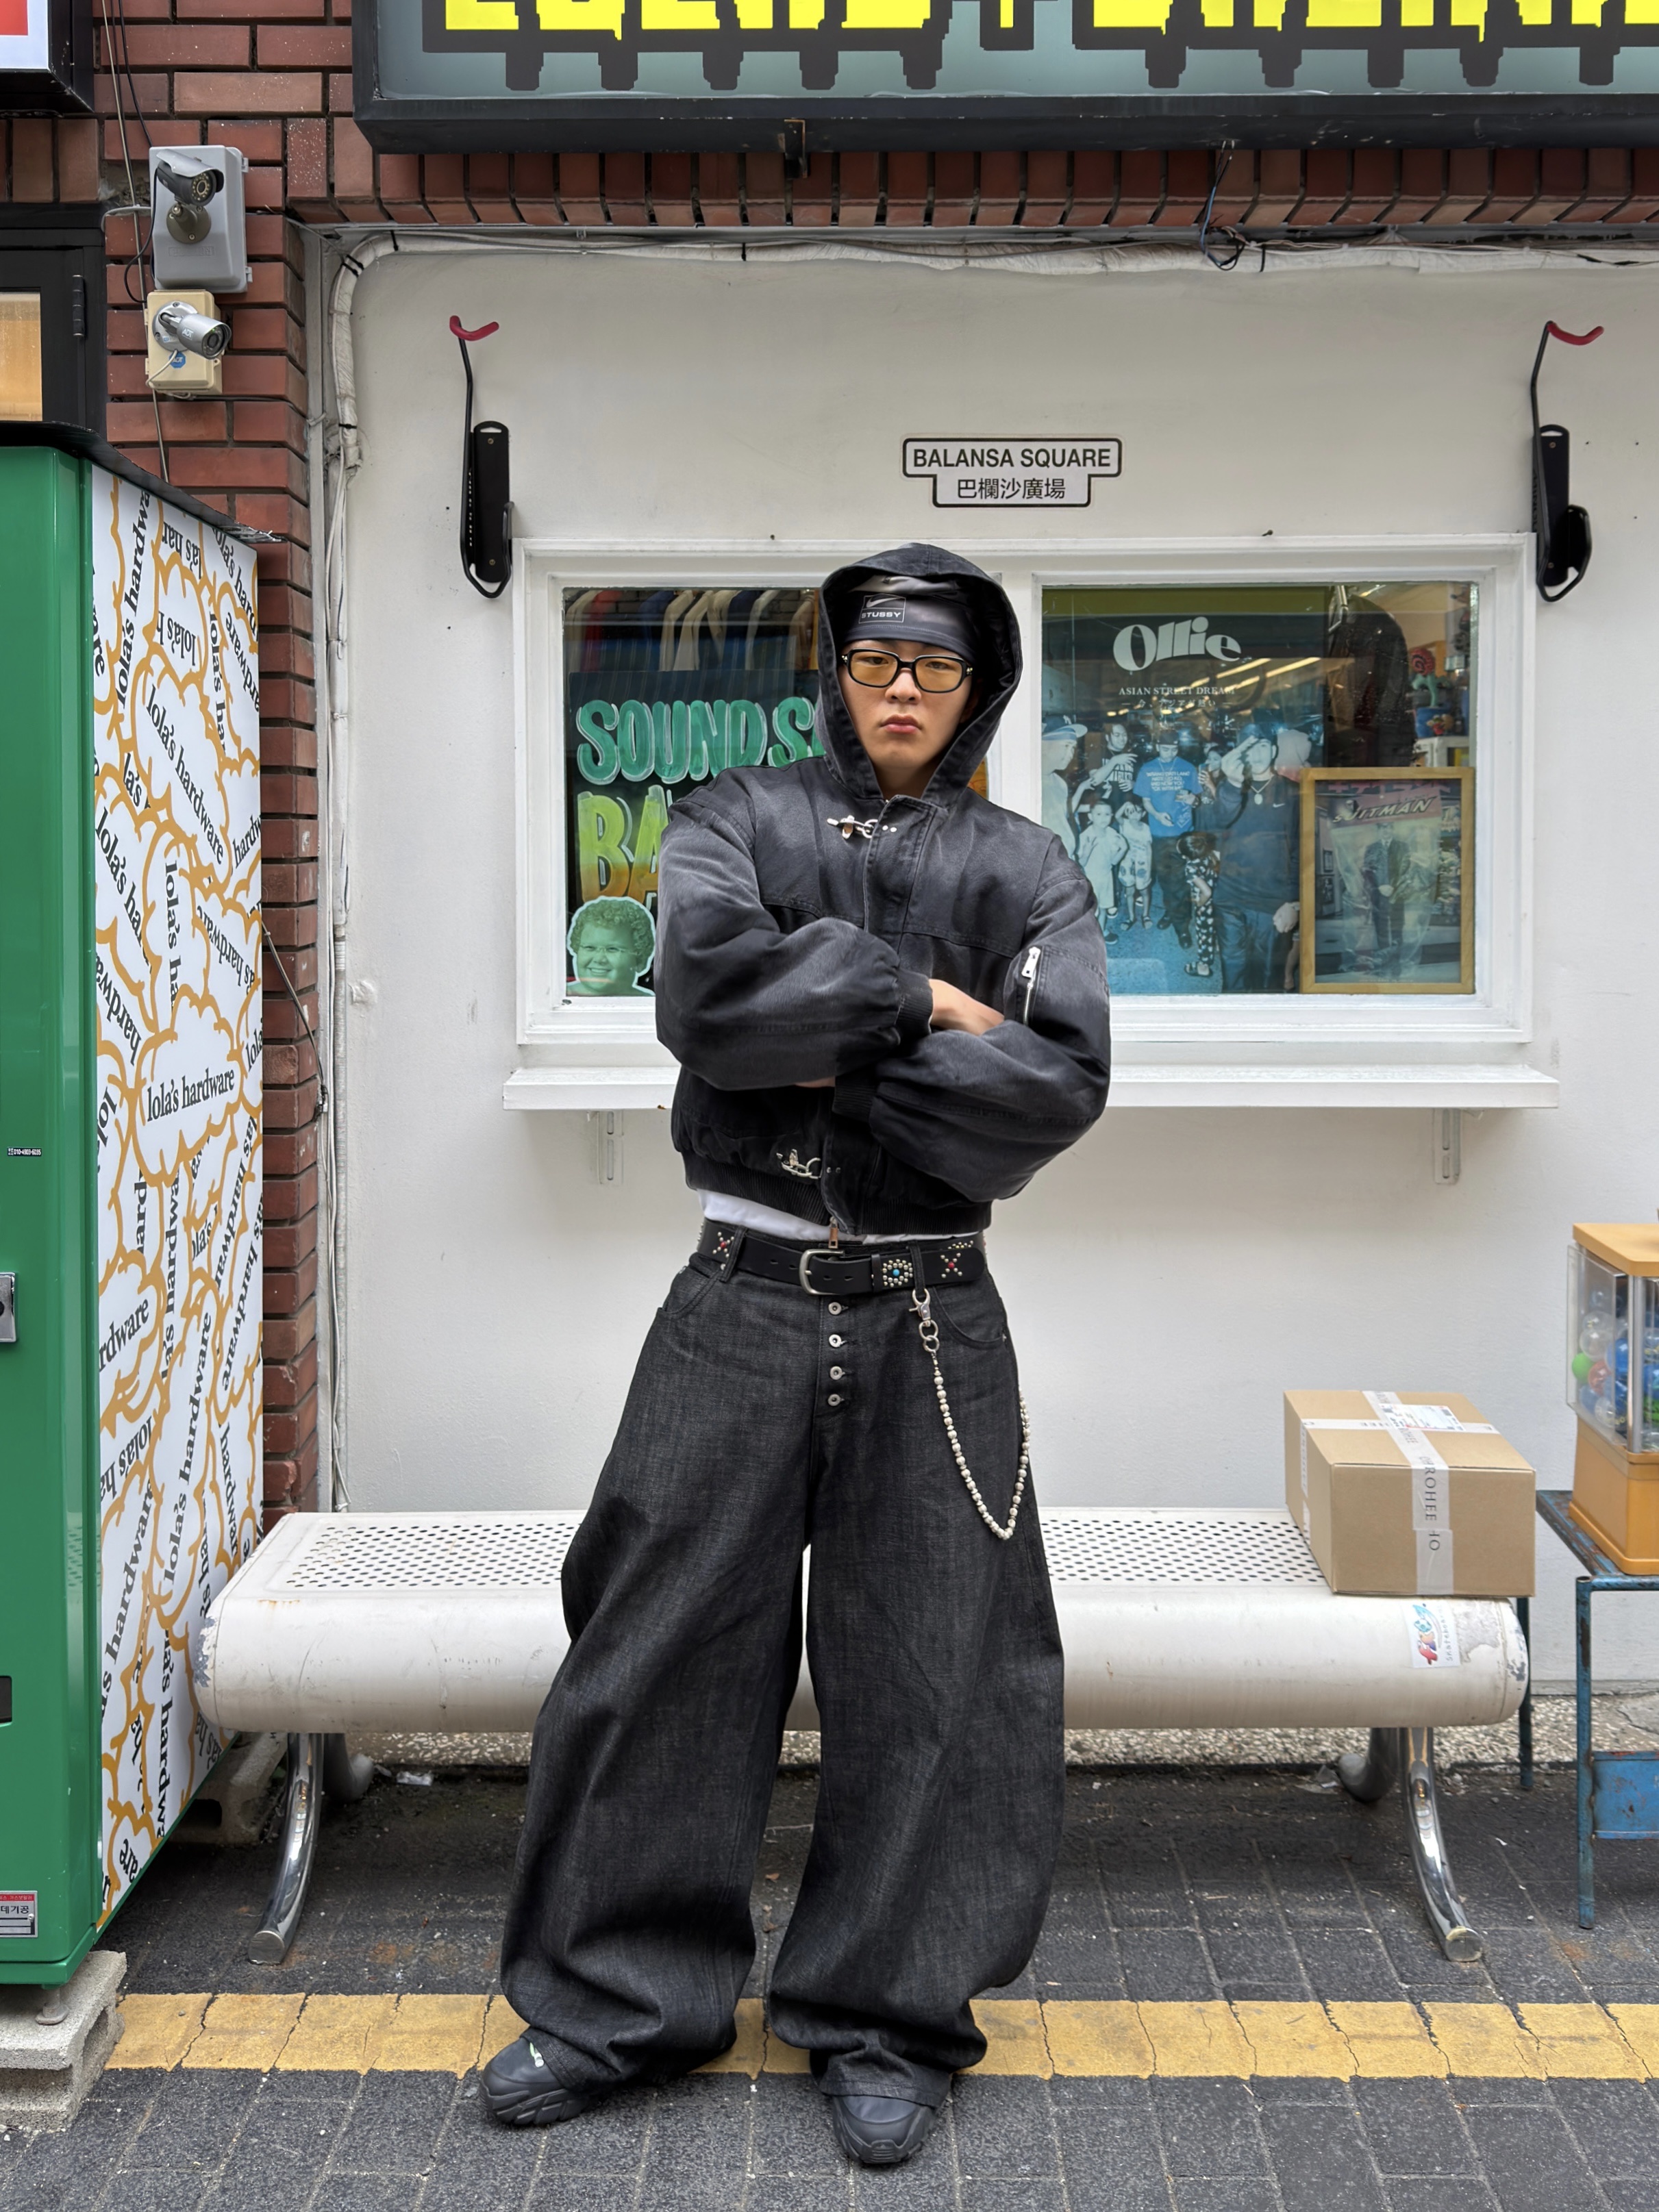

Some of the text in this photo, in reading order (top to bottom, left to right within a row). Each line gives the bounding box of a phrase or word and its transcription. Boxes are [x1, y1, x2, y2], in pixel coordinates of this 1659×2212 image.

[182, 328, 195, 338] ADT
[913, 448, 1111, 468] BALANSA SQUARE
[957, 478, 1066, 499] 巴欄沙廣場
[1113, 616, 1242, 671] Ollie
[1119, 687, 1235, 696] ASIAN STREET DREAM
[146, 683, 224, 865] lola's hardware
[1333, 796, 1438, 822] SUITMAN
[95, 807, 127, 895] lola's
[165, 860, 180, 949] lola's
[147, 1067, 235, 1122] lola's hardware
[164, 1311, 212, 1585] lola's hardware
